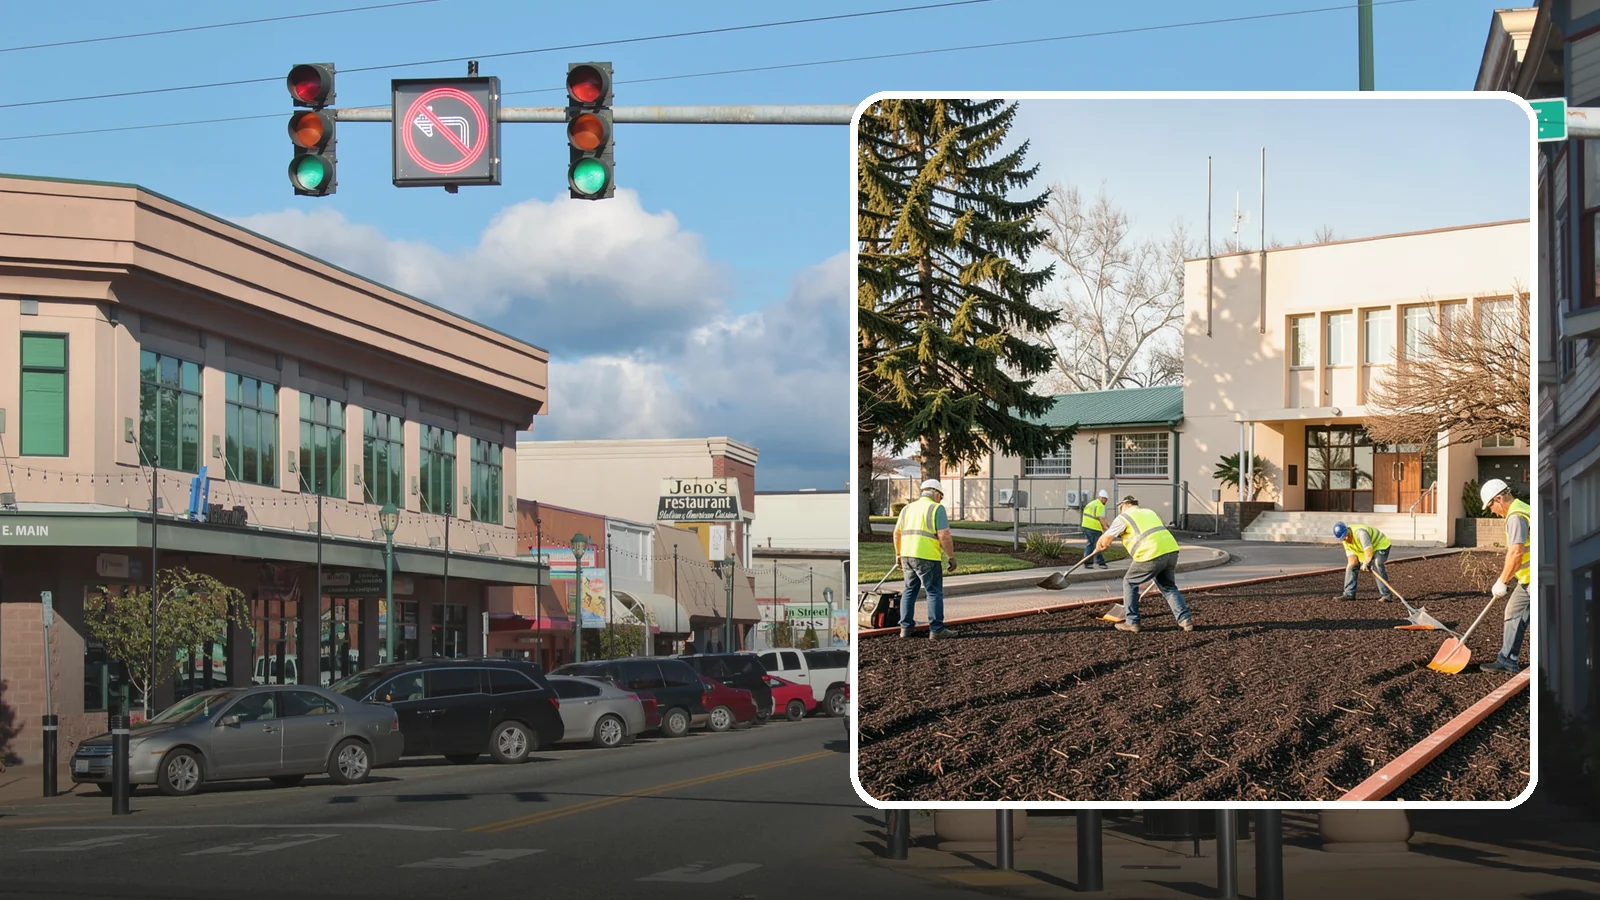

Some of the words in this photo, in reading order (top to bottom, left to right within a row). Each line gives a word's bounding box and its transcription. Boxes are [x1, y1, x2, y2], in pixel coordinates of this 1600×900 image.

[670, 480, 727, 494] Jeno's
[665, 496, 731, 509] restaurant
[659, 510, 681, 519] Italian
[686, 509, 714, 519] American
[715, 509, 737, 519] Cuisine
[2, 525, 13, 536] E.
[15, 525, 49, 536] MAIN
[797, 607, 828, 616] Street
